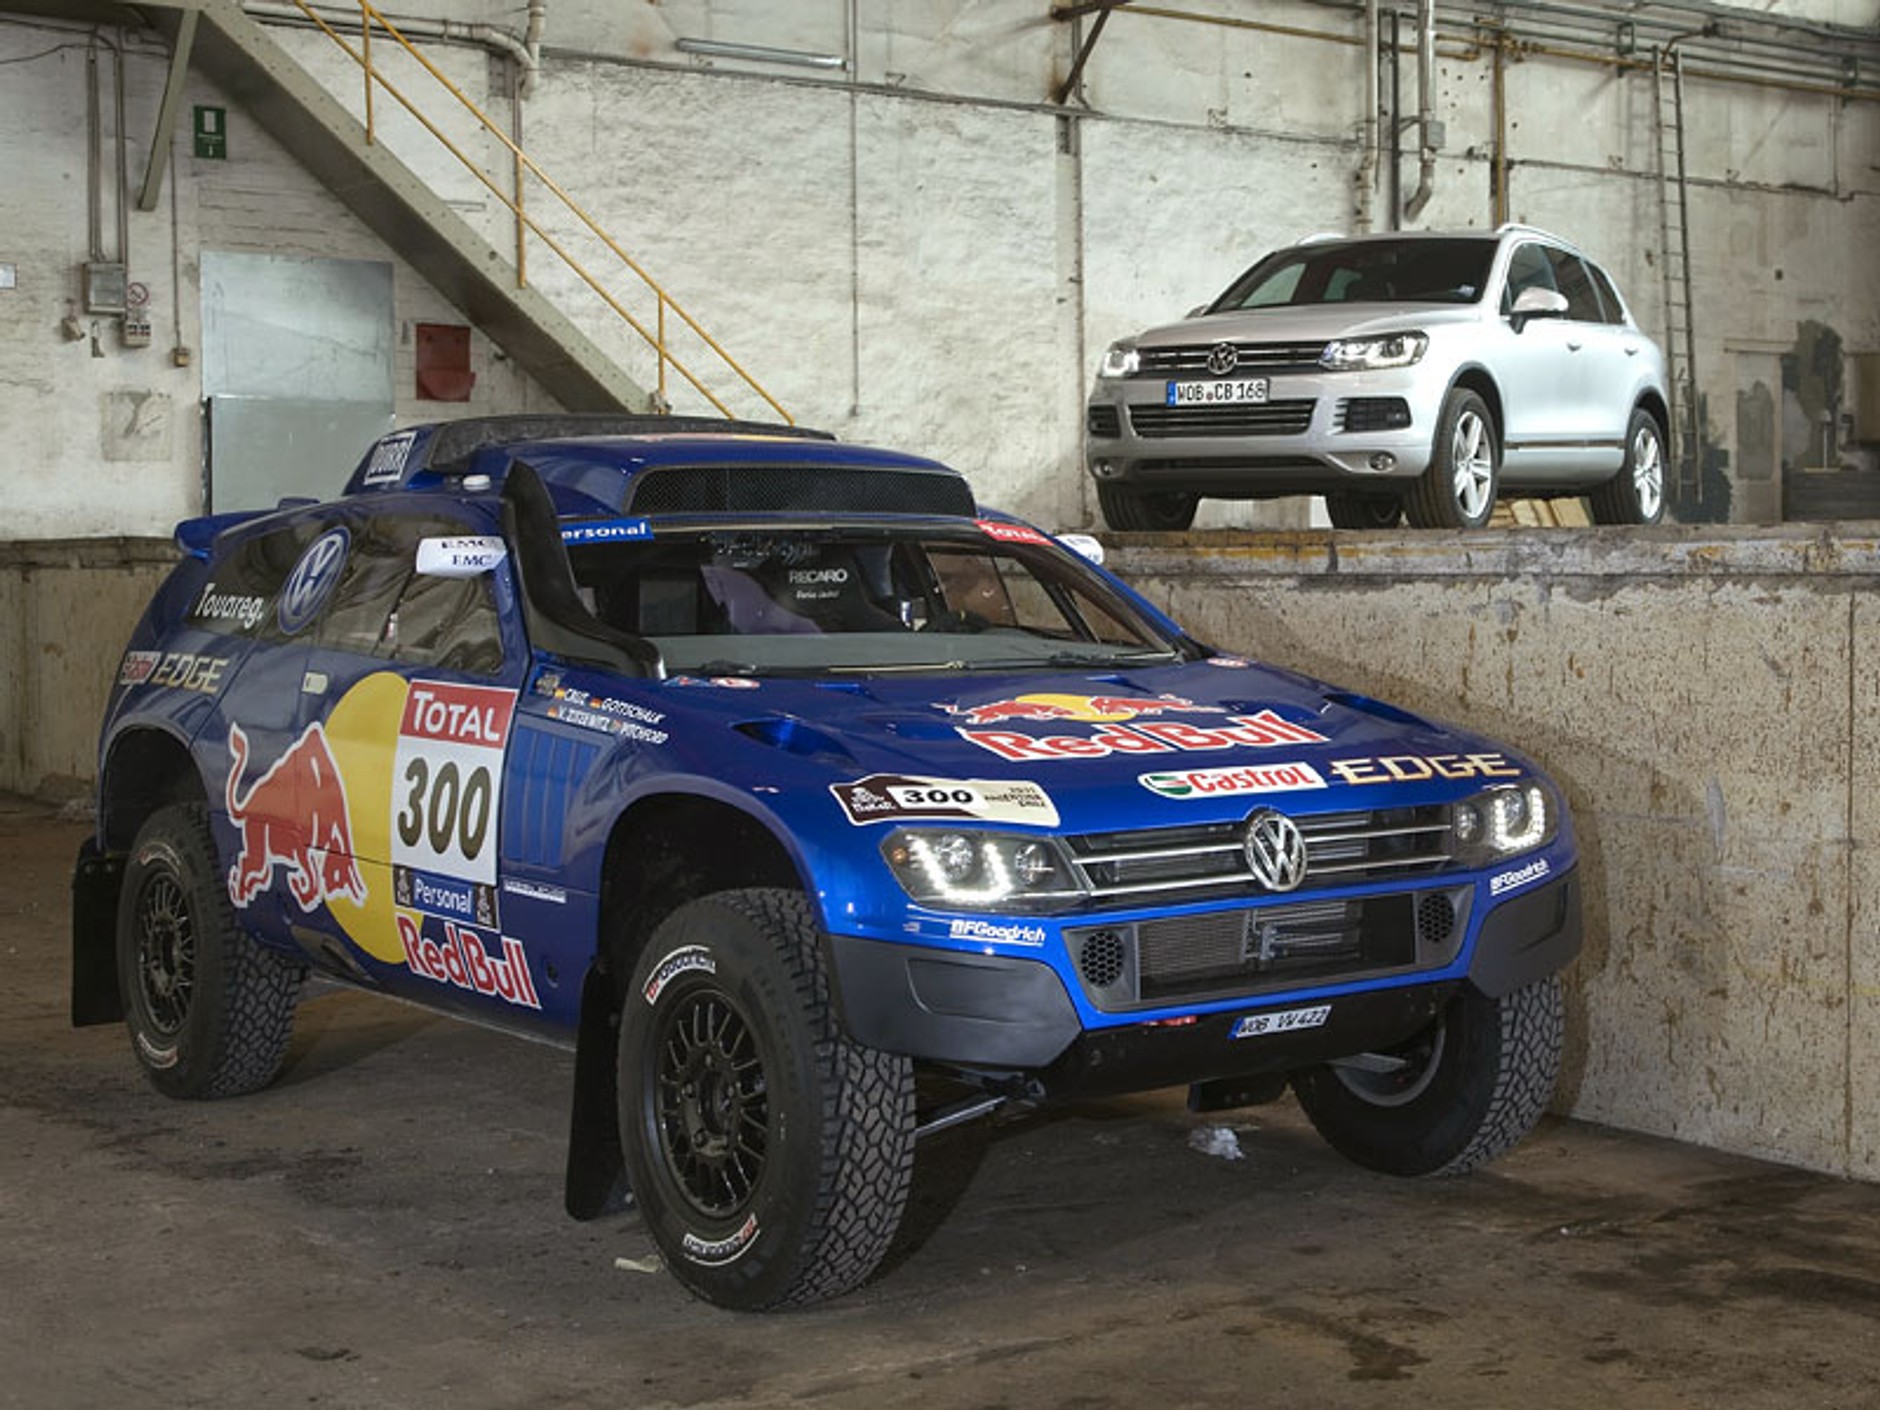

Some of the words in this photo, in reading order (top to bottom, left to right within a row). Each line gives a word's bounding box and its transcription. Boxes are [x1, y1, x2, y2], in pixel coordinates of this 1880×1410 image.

[1178, 385, 1204, 401] WOB
[1214, 383, 1233, 401] CB
[1236, 382, 1266, 400] 168
[561, 521, 646, 539] ersonal
[789, 568, 848, 584] RECARO
[151, 653, 229, 694] EDGE
[962, 724, 1175, 760] Red
[1133, 711, 1329, 749] Bull
[1188, 762, 1315, 792] Castrol
[1329, 753, 1521, 785] EDGE
[398, 757, 492, 861] 300
[904, 789, 974, 804] 300
[414, 877, 473, 914] Personal
[950, 919, 1046, 946] BFGoodrich
[396, 913, 472, 989] Red
[459, 929, 540, 1009] Bull
